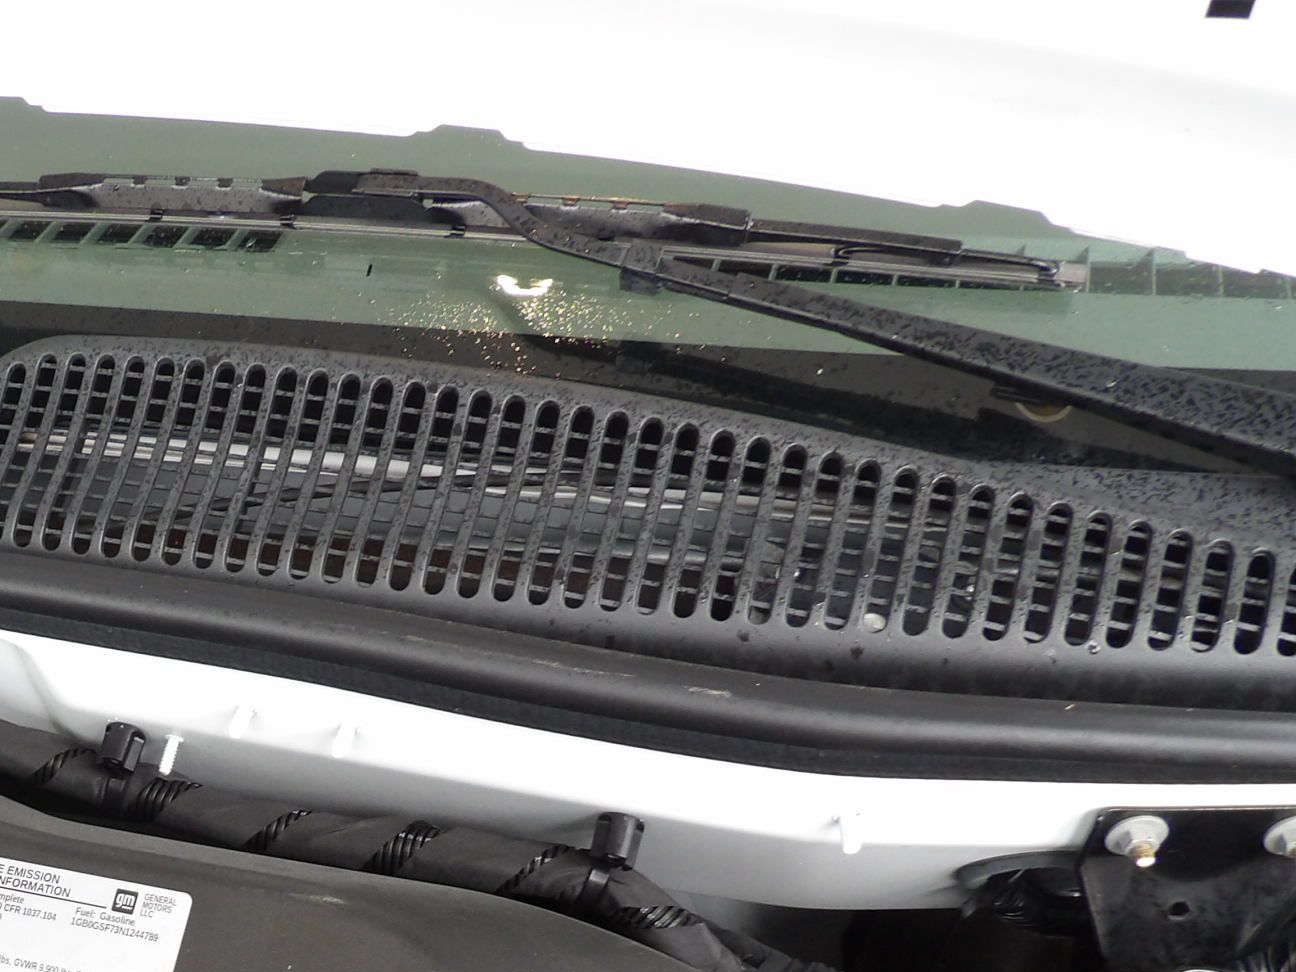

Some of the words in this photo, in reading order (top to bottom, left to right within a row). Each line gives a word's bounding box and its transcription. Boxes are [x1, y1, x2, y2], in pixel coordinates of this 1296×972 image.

[6, 865, 61, 885] EMISSION
[113, 891, 137, 912] gm
[142, 900, 173, 914] MOTORS
[144, 893, 177, 907] GENERAL
[3, 903, 22, 915] CFR
[22, 907, 57, 921] 1037.104
[74, 906, 96, 919] Fuel:
[99, 911, 136, 927] Gasoline
[139, 909, 154, 919] LLC
[70, 916, 159, 942] 1GB0GSF73N1244789
[13, 958, 38, 971] GVWR
